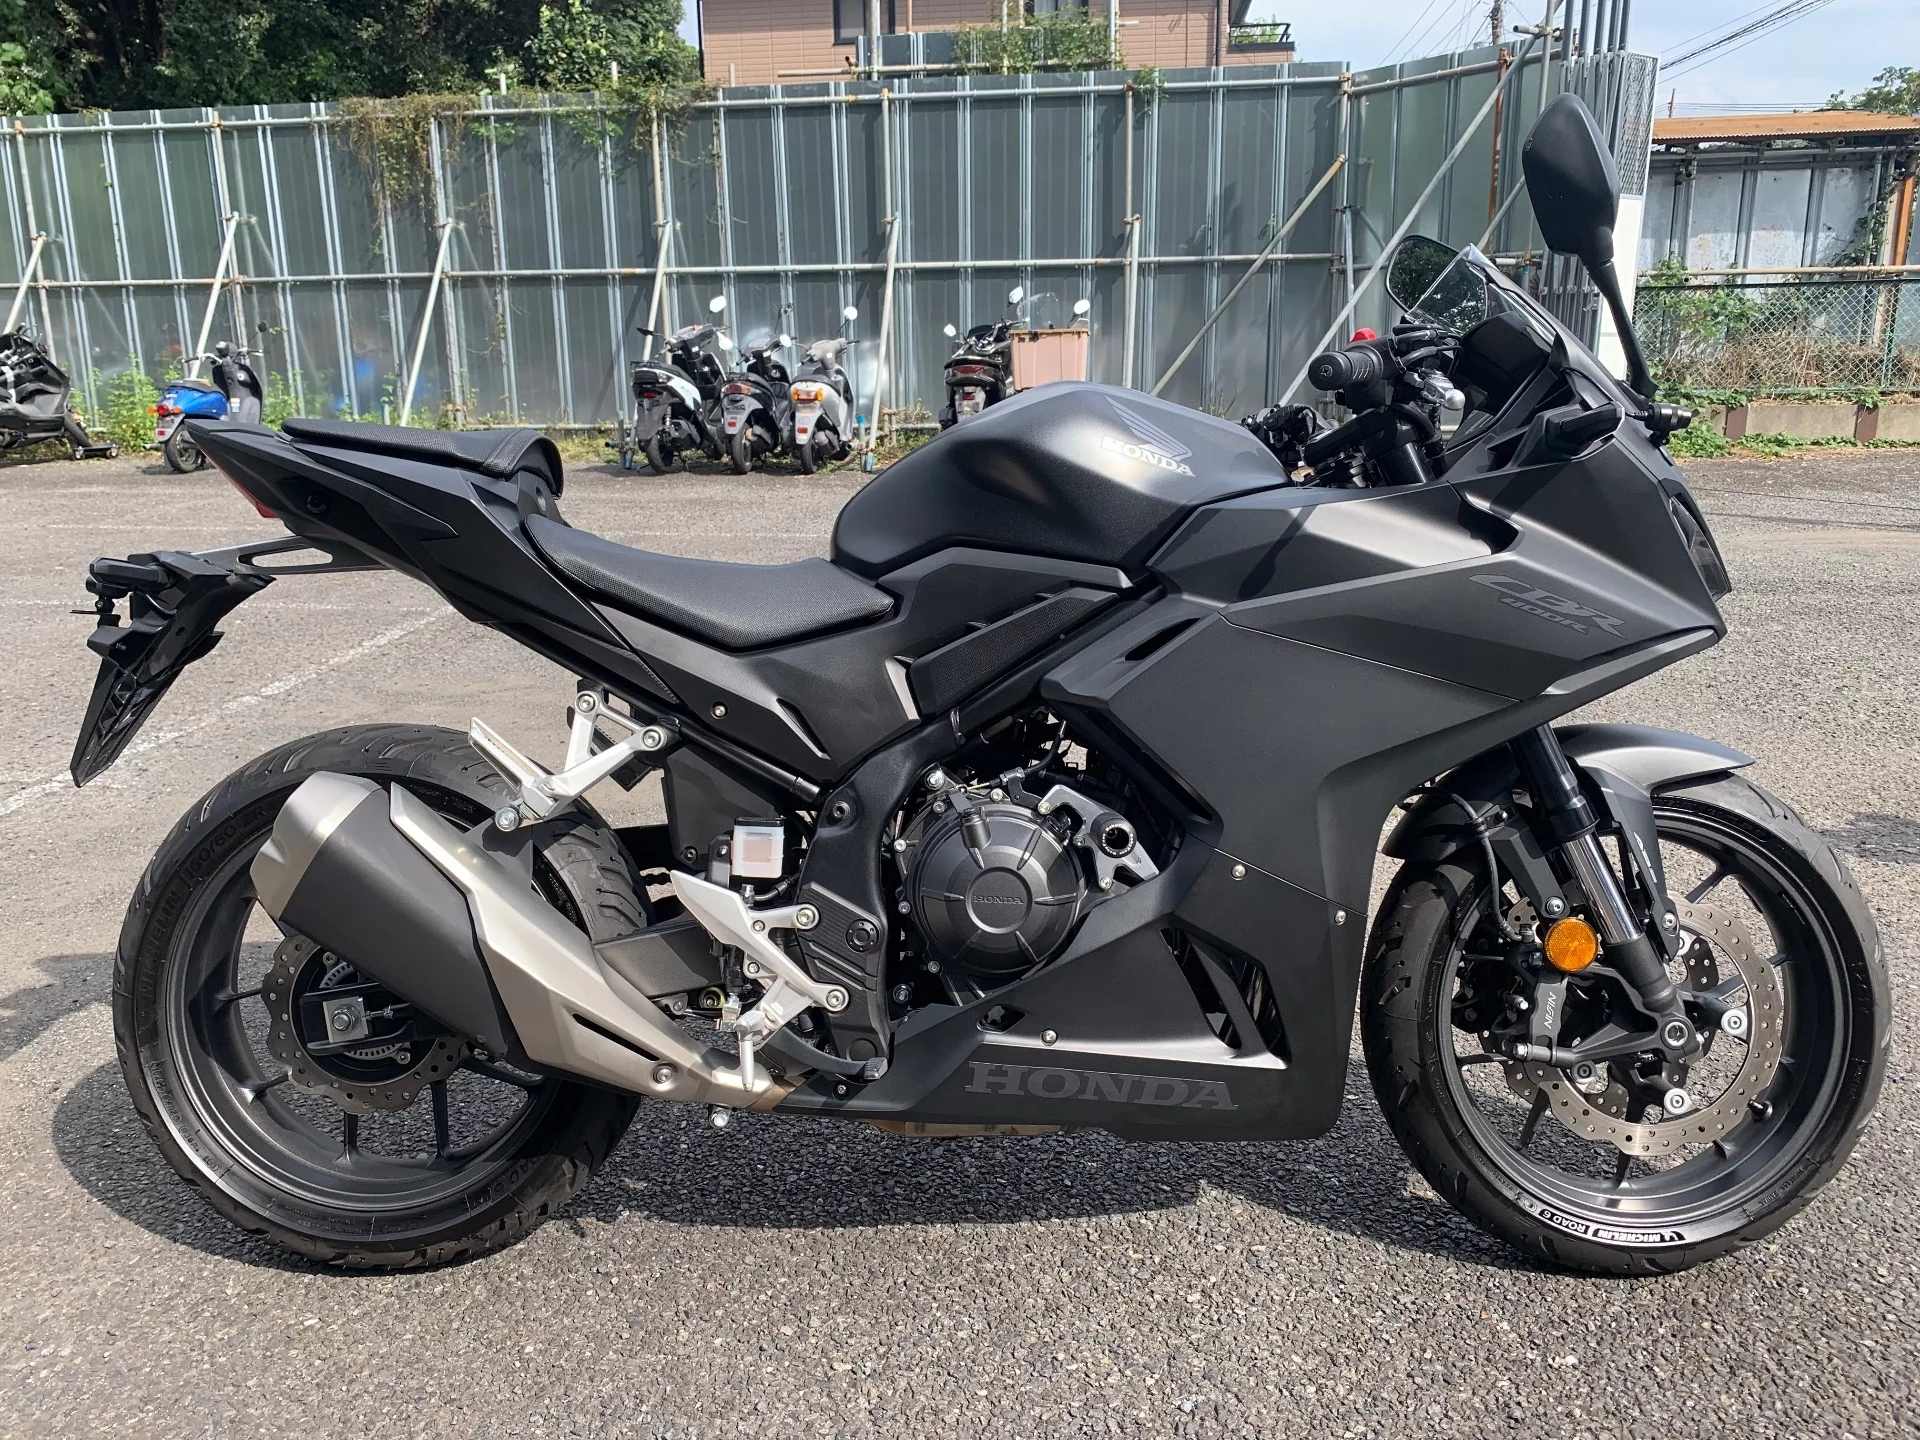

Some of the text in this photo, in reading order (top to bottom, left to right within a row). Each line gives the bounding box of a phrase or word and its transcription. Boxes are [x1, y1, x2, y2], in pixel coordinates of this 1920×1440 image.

[1101, 435, 1195, 476] HONDA
[1469, 574, 1627, 640] CBR
[973, 895, 1024, 904] HONDA
[965, 1061, 1239, 1111] HONDA
[1543, 1210, 1661, 1242] MICHELIN ROAD 6
